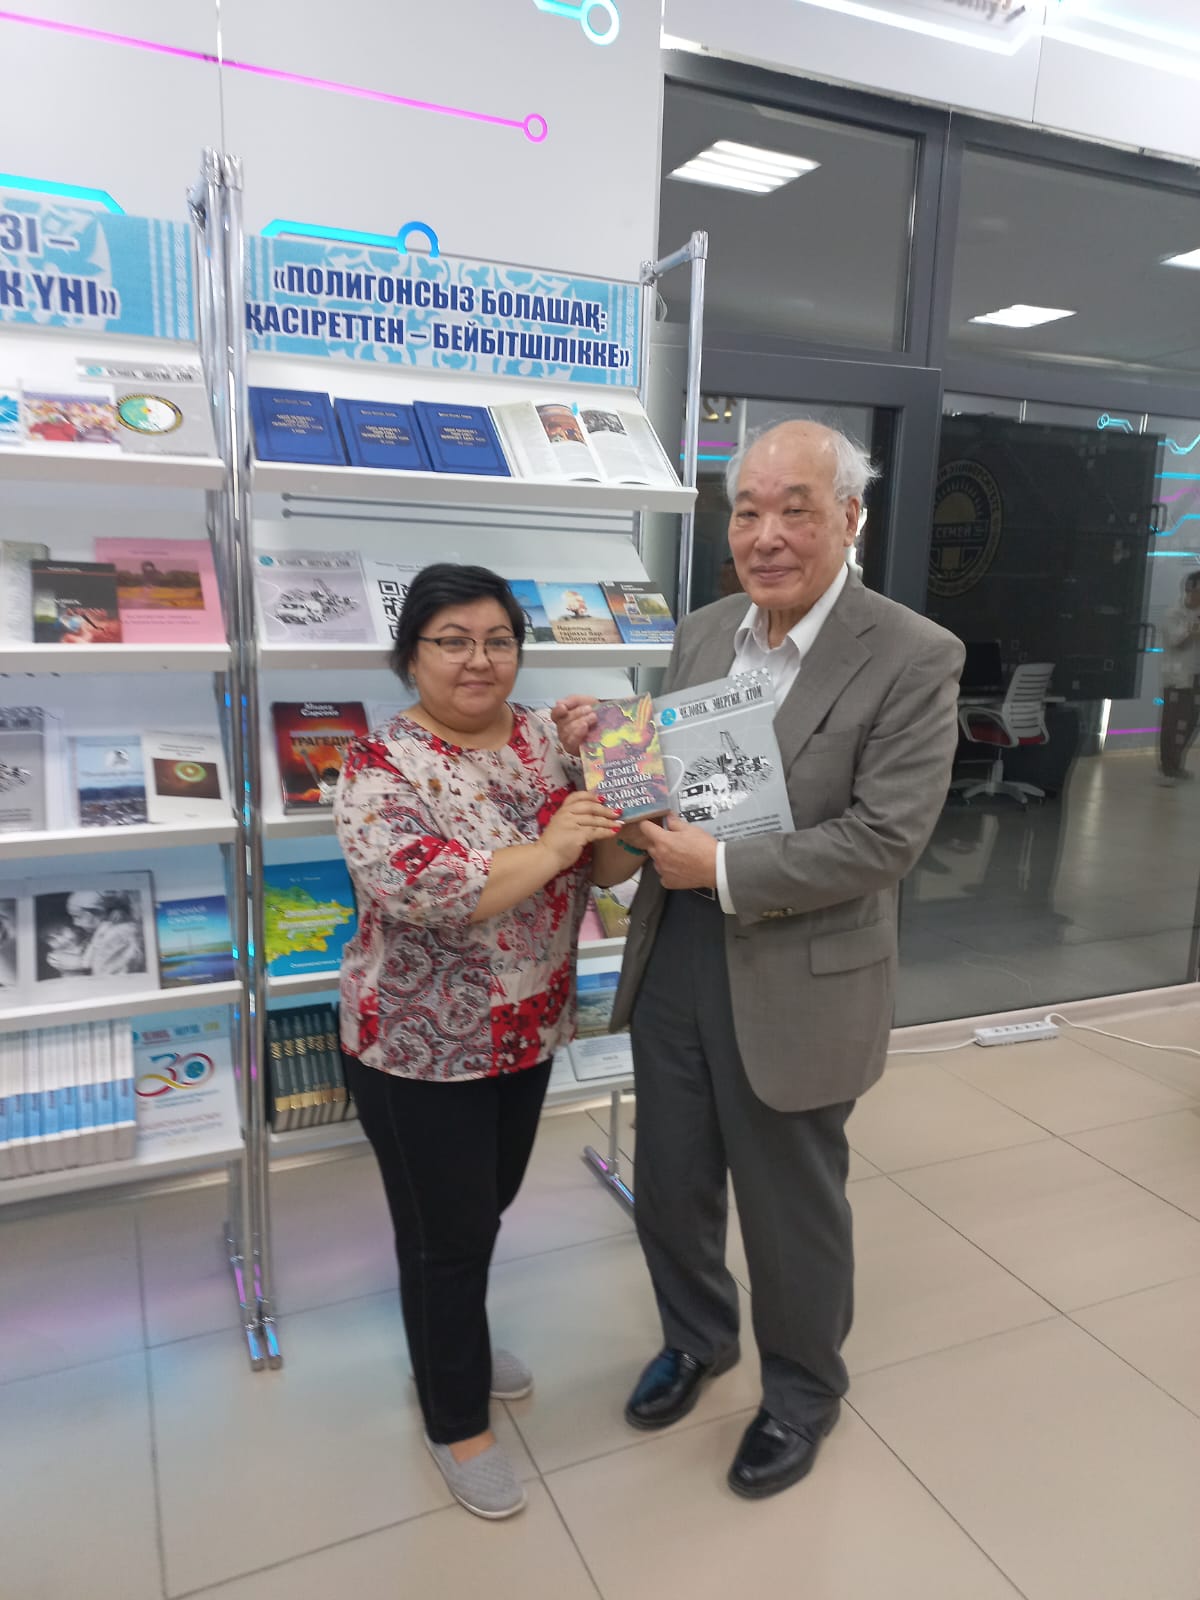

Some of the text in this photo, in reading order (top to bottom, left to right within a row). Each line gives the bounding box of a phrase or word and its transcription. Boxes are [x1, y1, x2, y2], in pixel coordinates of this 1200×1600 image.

[274, 265, 607, 333] «ПОЛИГОНСЫЗ БОЛАШАҚ:
[245, 303, 404, 344] ҚАСІРЕТТЕН
[433, 321, 630, 368] БЕЙБІТШІЛІККЕ»
